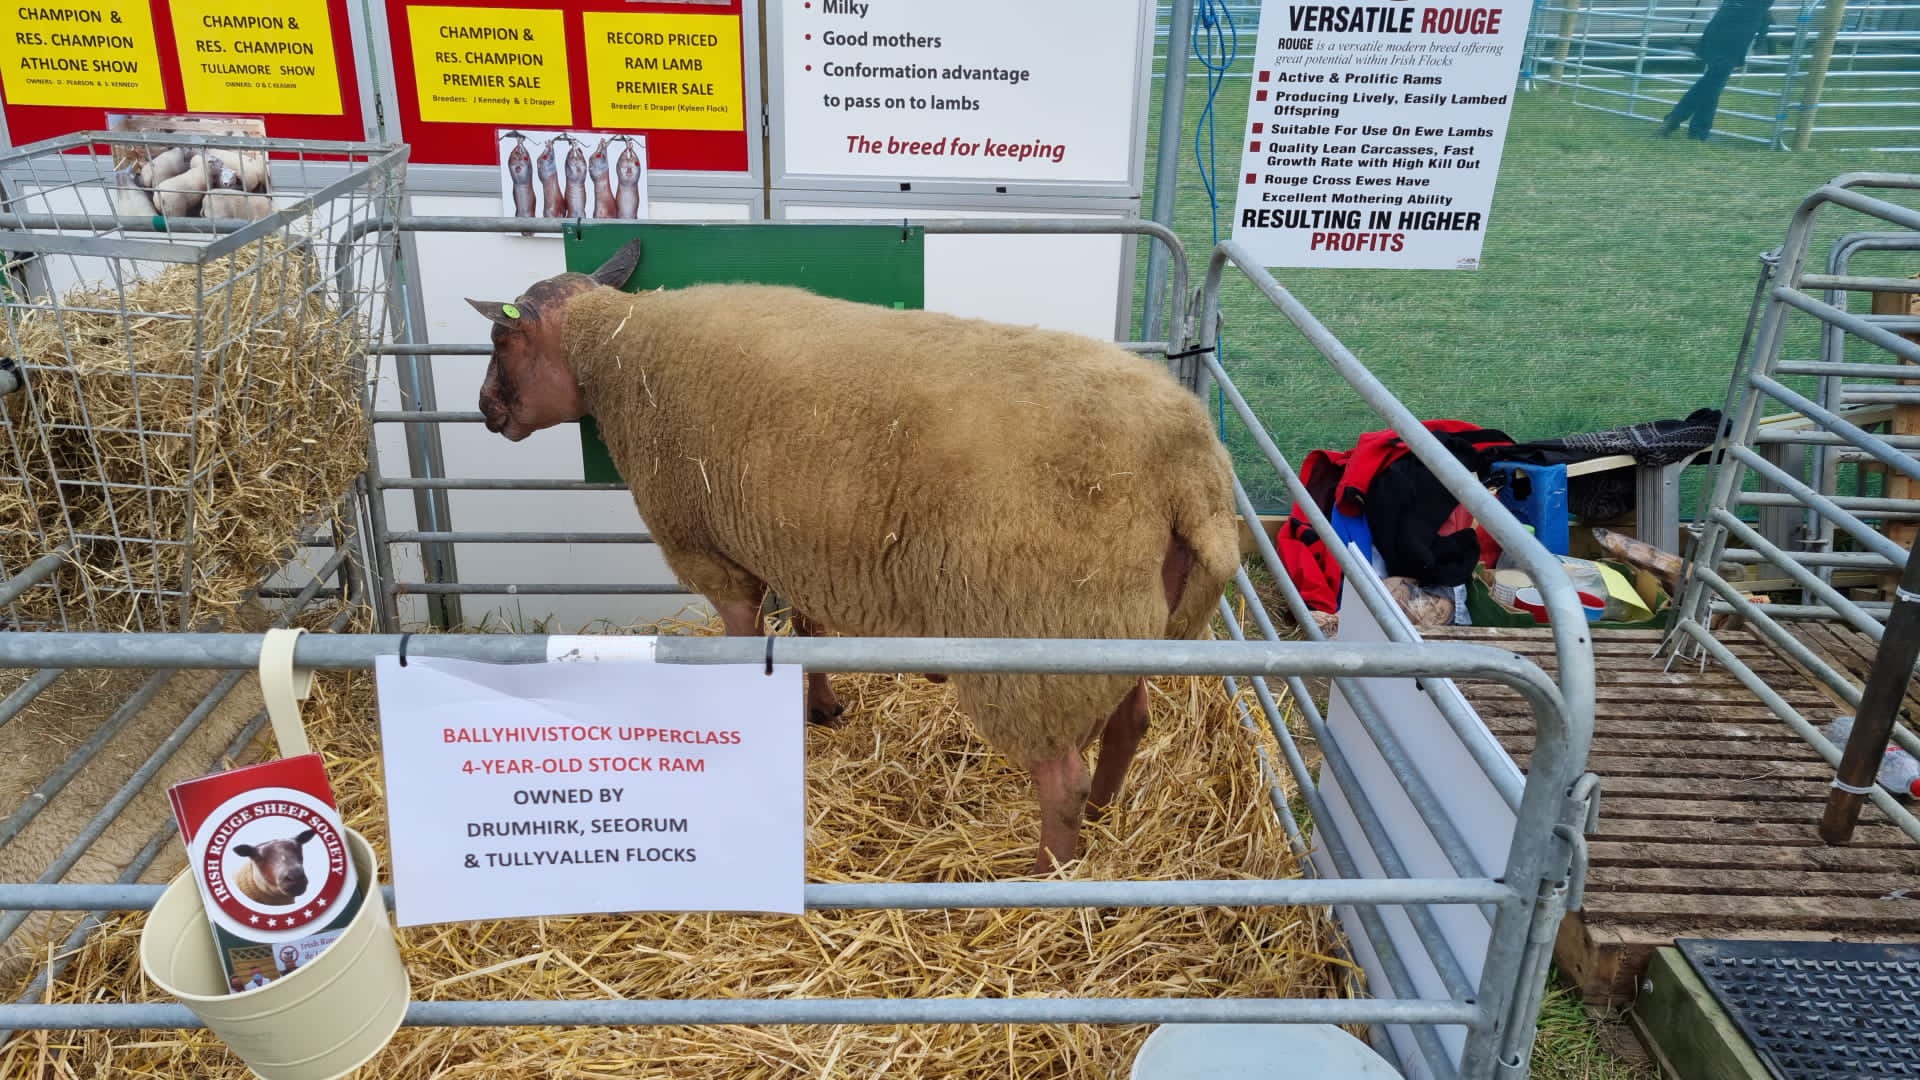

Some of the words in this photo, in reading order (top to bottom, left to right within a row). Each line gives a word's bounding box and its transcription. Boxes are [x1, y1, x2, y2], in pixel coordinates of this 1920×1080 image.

[18, 8, 102, 23] CHAMPION
[110, 11, 122, 24] &
[822, 0, 869, 18] Milky
[202, 15, 283, 30] CHAMPION
[287, 17, 300, 30] &
[1289, 6, 1415, 33] VERSATILE
[1421, 7, 1503, 35] ROUGE
[16, 32, 48, 46] RES.
[51, 34, 134, 49] CHAMPION
[439, 26, 520, 41] CHAMPION
[523, 28, 534, 42] &
[607, 31, 664, 46] RECORD
[668, 33, 718, 48] PRICED
[823, 31, 868, 48] Good
[872, 32, 942, 48] mothers
[196, 40, 226, 52] RES.
[234, 41, 314, 55] CHAMPION
[1278, 38, 1313, 50] ROUGE
[1316, 42, 1325, 50] is
[1338, 41, 1383, 51] versatile
[1386, 42, 1426, 52] modern
[1429, 42, 1458, 53] breed
[1461, 42, 1504, 56] offering
[20, 57, 89, 72] ATHLONE
[93, 60, 138, 73] SHOW
[435, 51, 462, 64] RES.
[465, 52, 544, 67] CHAMPION
[624, 57, 660, 70] RAM
[662, 58, 703, 72] LAMB
[1275, 54, 1302, 66] great
[1304, 54, 1352, 66] potential
[1355, 54, 1389, 65] within
[1390, 55, 1415, 66] Irish
[1418, 55, 1453, 66] Flocks
[201, 63, 271, 75] TULLAMORE
[280, 66, 315, 76] SHOW
[823, 62, 938, 79] Conformation
[942, 65, 1030, 85] advantage
[443, 73, 506, 88] PREMIER
[509, 75, 541, 89] SALE
[1278, 72, 1324, 83] Active
[1329, 73, 1339, 84] &
[1345, 73, 1398, 84] Prolific
[1403, 74, 1442, 85] Rams
[616, 81, 679, 95] PREMIER
[682, 83, 714, 96] SALE
[479, 97, 510, 105] Kennedy
[530, 98, 555, 106] Draper
[823, 95, 840, 108] to
[845, 96, 881, 112] pass
[885, 96, 905, 110] on
[910, 96, 926, 110] to
[930, 95, 980, 111] lambs
[1276, 91, 1348, 105] Producing
[1353, 92, 1398, 106] Lively,
[1404, 93, 1446, 107] Easily
[1451, 94, 1507, 105] Lambed
[651, 104, 675, 112] Draper
[1274, 105, 1340, 118] Offspring
[1272, 124, 1329, 135] Suitable
[1335, 125, 1357, 135] For
[1362, 125, 1388, 136] Use
[1392, 125, 1410, 136] On
[1415, 126, 1443, 137] Ewe
[1448, 126, 1494, 137] Lambs
[847, 136, 882, 154] The
[888, 137, 946, 156] breed
[950, 137, 980, 157] for
[984, 138, 1065, 162] keeping
[1269, 143, 1318, 155] Quality
[1323, 143, 1355, 154] Lean
[1361, 144, 1438, 156] Carcasses,
[1443, 145, 1474, 155] Fast
[1267, 156, 1316, 167] Growth
[1321, 157, 1353, 167] Rate
[1358, 157, 1388, 168] with
[1392, 158, 1423, 170] High
[1428, 158, 1452, 169] Kill
[1456, 158, 1480, 169] Out
[1264, 174, 1308, 186] Rouge
[1312, 175, 1351, 186] Cross
[1356, 176, 1391, 186] Ewes
[1396, 176, 1430, 186] Have
[1262, 192, 1327, 203] Excellent
[1332, 193, 1402, 206] Mothering
[1408, 194, 1453, 206] Ability
[1242, 209, 1361, 229] RESULTING
[1368, 211, 1392, 229] IN
[1398, 211, 1481, 230] HIGHER
[1311, 233, 1405, 251] PROFITS
[443, 725, 612, 744] BALLYHIVISTOCK
[618, 726, 741, 745] UPPERCLASS
[462, 757, 583, 776] 4-YEAR-OLD
[589, 757, 652, 772] STOCK
[659, 757, 705, 772] RAM
[513, 787, 593, 805] OWNED
[600, 787, 624, 802] BY
[253, 804, 309, 818] SHEEP
[210, 809, 256, 856] ROUGE
[467, 819, 585, 838] DRUMHIRK,
[591, 817, 688, 833] SEEORUM
[308, 816, 344, 875] SOCIETY
[464, 853, 480, 868] &
[485, 849, 620, 867] TULLYVALLEN
[626, 846, 696, 863] FLOCKS
[208, 859, 230, 902] IRISH
